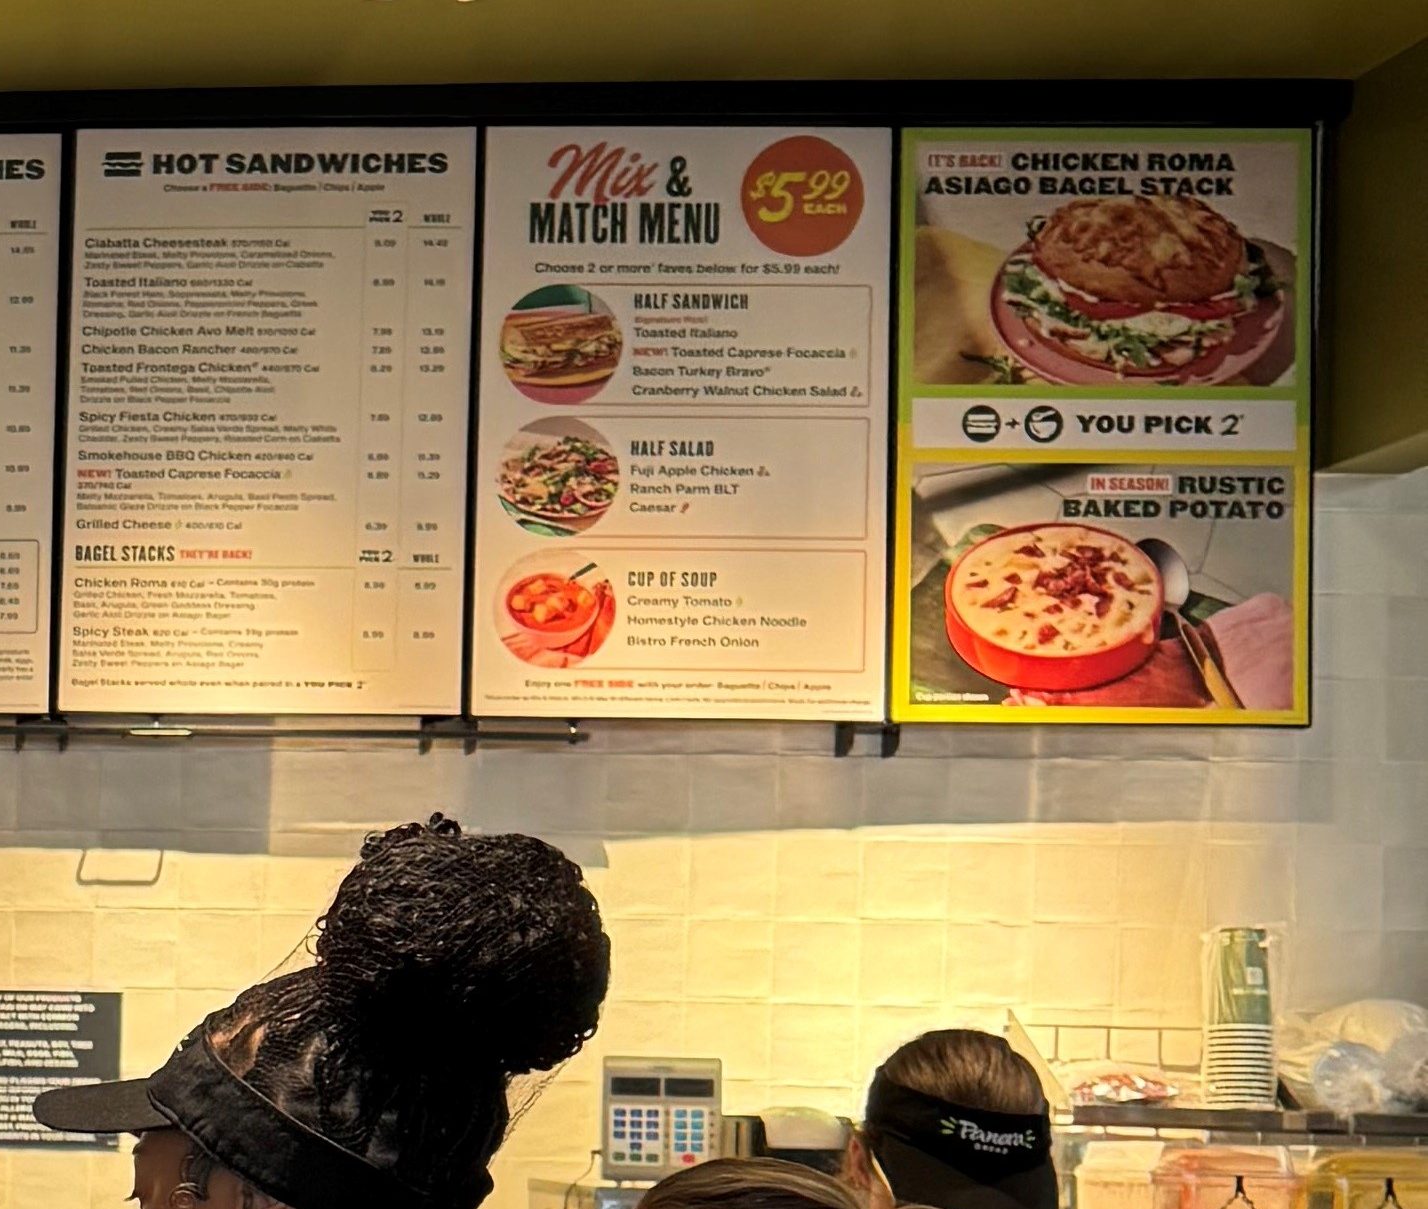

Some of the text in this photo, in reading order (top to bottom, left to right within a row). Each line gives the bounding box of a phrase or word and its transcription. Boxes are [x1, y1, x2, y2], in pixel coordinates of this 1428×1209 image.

[152, 153, 448, 174] HOT SANDWICHES
[927, 152, 1236, 173] IT'S BACK! CHICKEN ROMA
[547, 140, 693, 207] Mix &
[923, 176, 1234, 197] ASIAGO BAGEL STACK
[802, 202, 848, 216] EACH
[528, 201, 721, 245] MATCH MENU
[534, 262, 584, 273] Choose
[587, 262, 596, 273] 2
[598, 264, 614, 273] or
[657, 262, 694, 273] faves
[695, 263, 736, 273] below
[740, 263, 759, 273] for
[762, 263, 800, 274] $5.99
[633, 292, 748, 309] HALF SANDWICH
[633, 327, 738, 338] Toasted Italiano
[632, 365, 674, 376] Bacon
[677, 365, 722, 378] Turkey
[1076, 414, 1240, 436] YOU PICK 2
[77, 449, 251, 460] Smokehouse BBQ Chicken
[630, 440, 714, 456] HALF SALAD
[629, 483, 740, 494] Ranch Parm BLT
[1090, 476, 1286, 496] IN SEASON! RUSTIC
[1061, 499, 1286, 521] BAKED POTATO
[75, 544, 174, 561] BAGEL STACKS
[628, 571, 717, 587] CUP OF SOUP
[958, 1118, 1026, 1147] Panera
